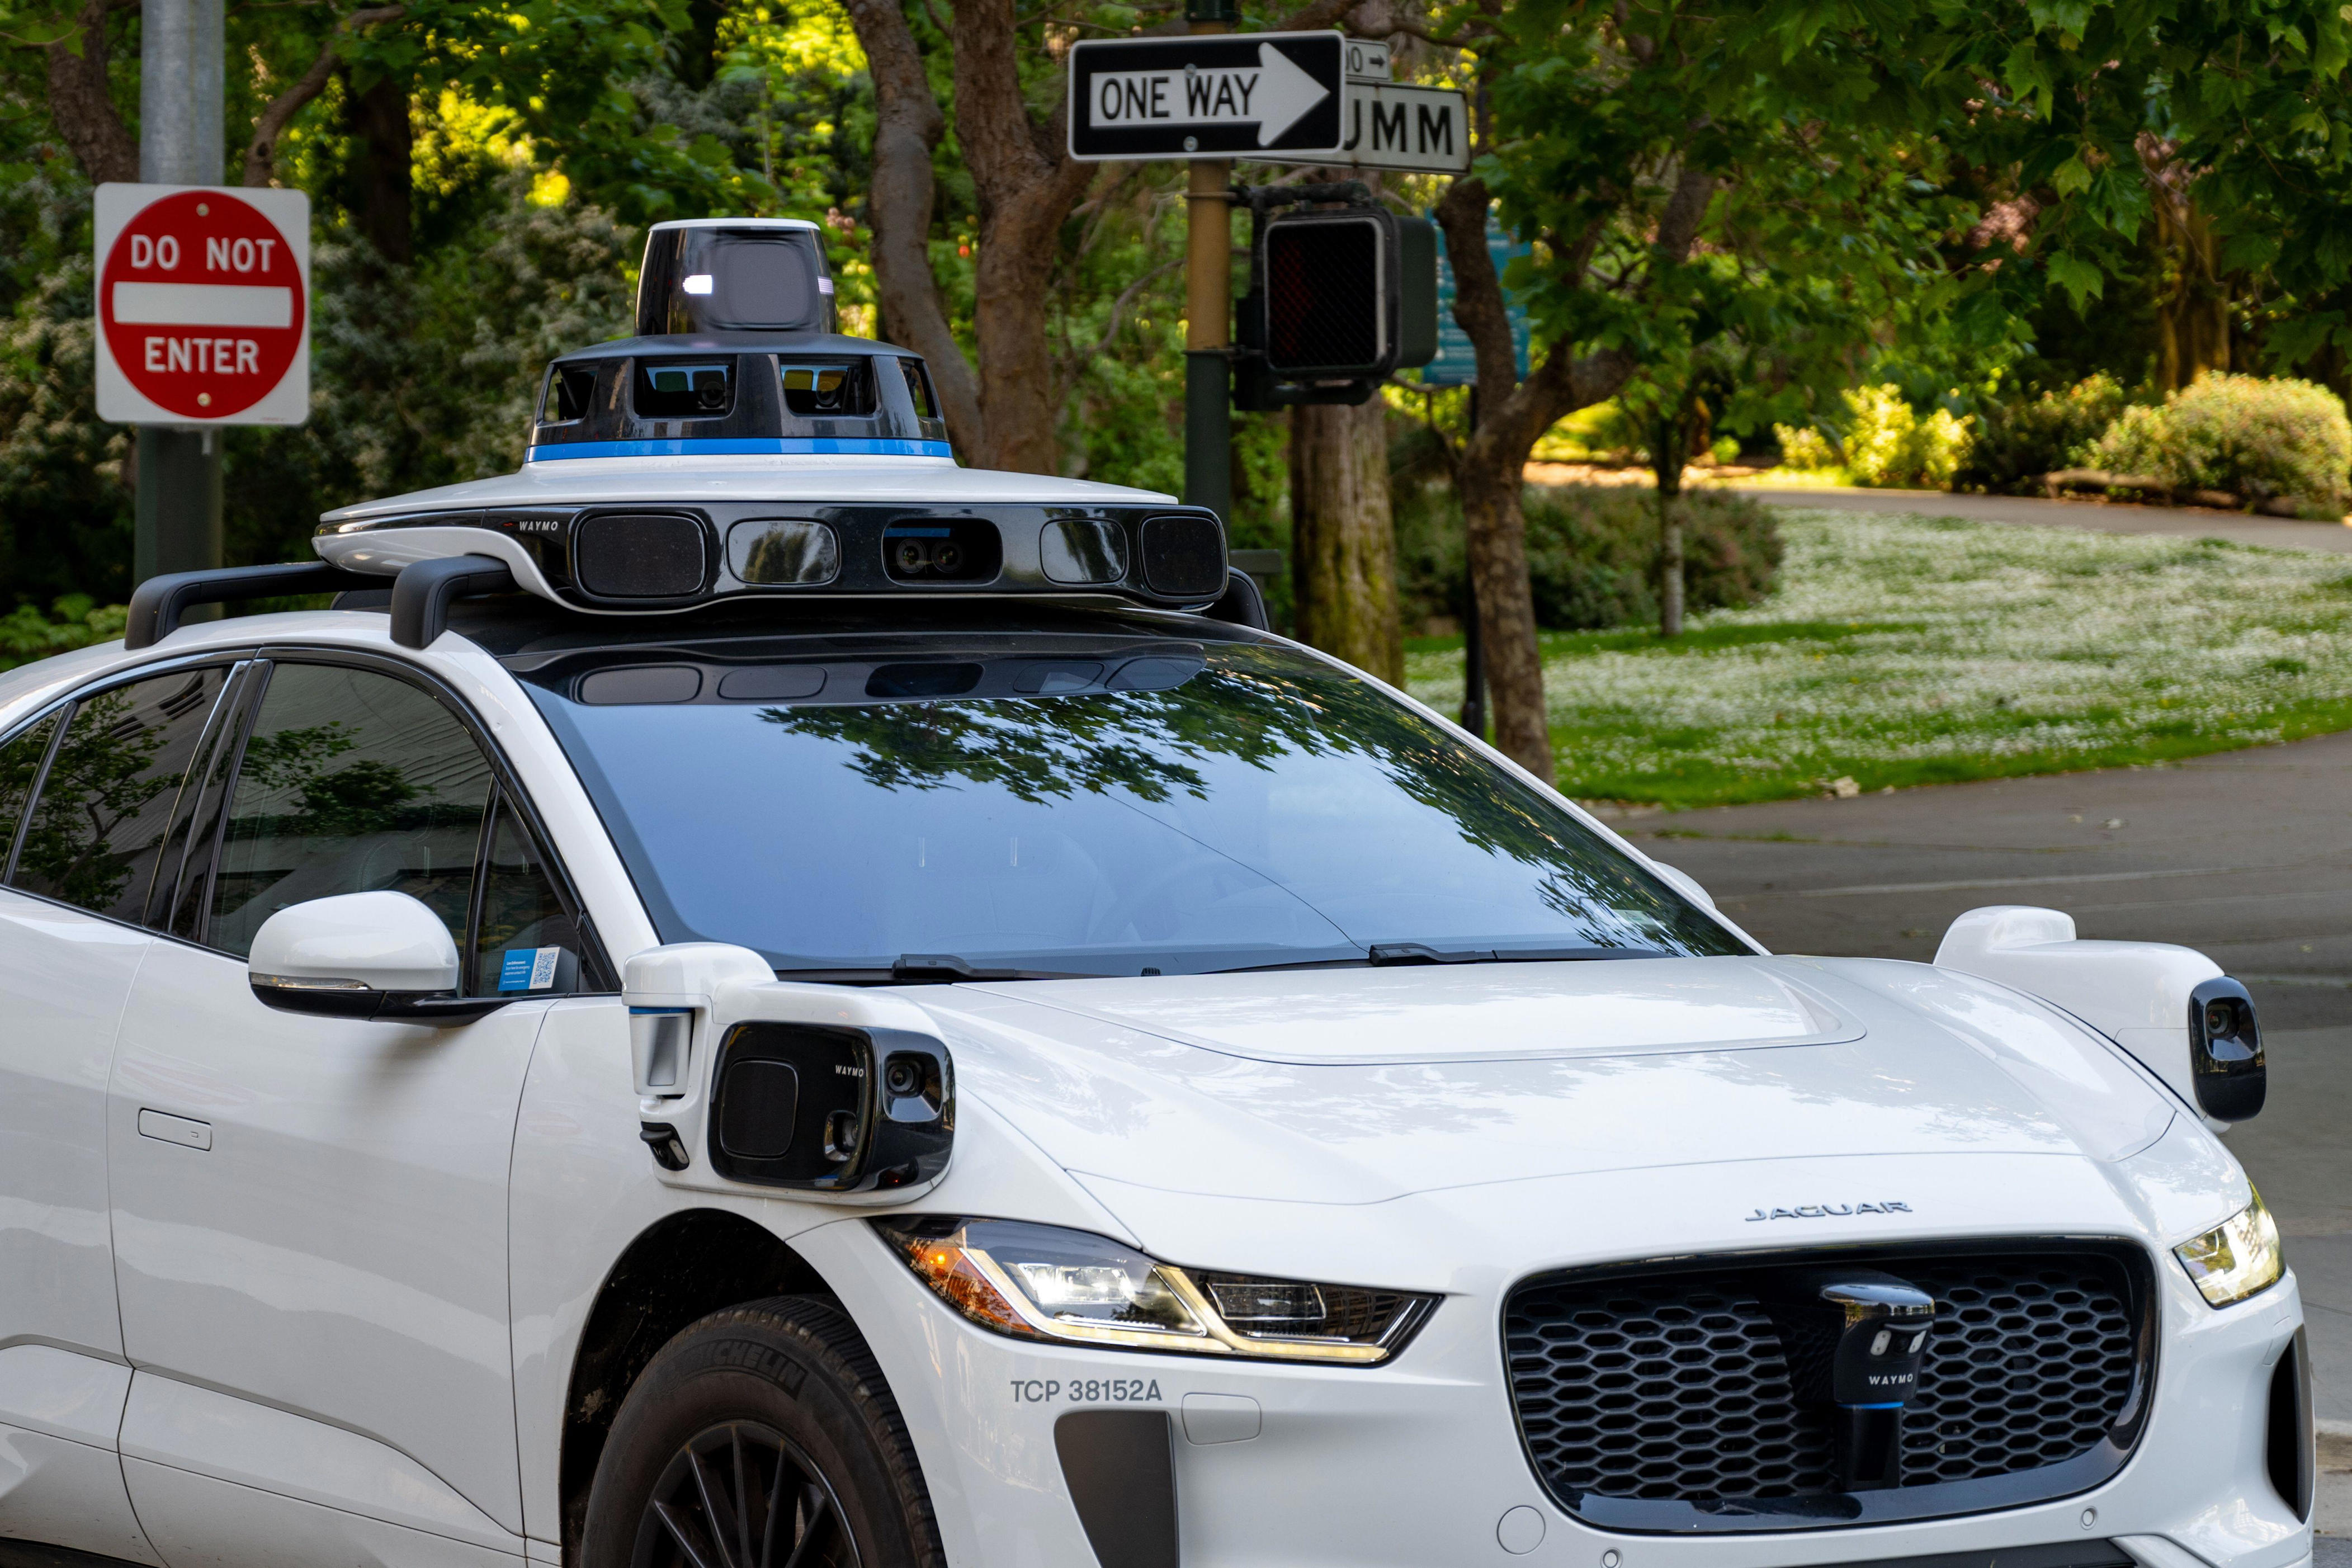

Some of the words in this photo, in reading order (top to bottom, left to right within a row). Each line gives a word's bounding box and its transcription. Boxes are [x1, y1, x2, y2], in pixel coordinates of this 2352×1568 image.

[1100, 77, 1170, 120] ONE
[1186, 73, 1259, 117] WAY
[131, 234, 181, 271] DO
[206, 236, 276, 273] NOT
[144, 336, 259, 374] ENTER
[519, 521, 559, 531] WAYMO
[835, 1065, 864, 1077] WAYMO
[1745, 1201, 1913, 1221] JAGUAR
[1868, 1373, 1914, 1385] WAYMO
[1010, 1380, 1060, 1402] TCP
[1068, 1379, 1163, 1401] 38152A
